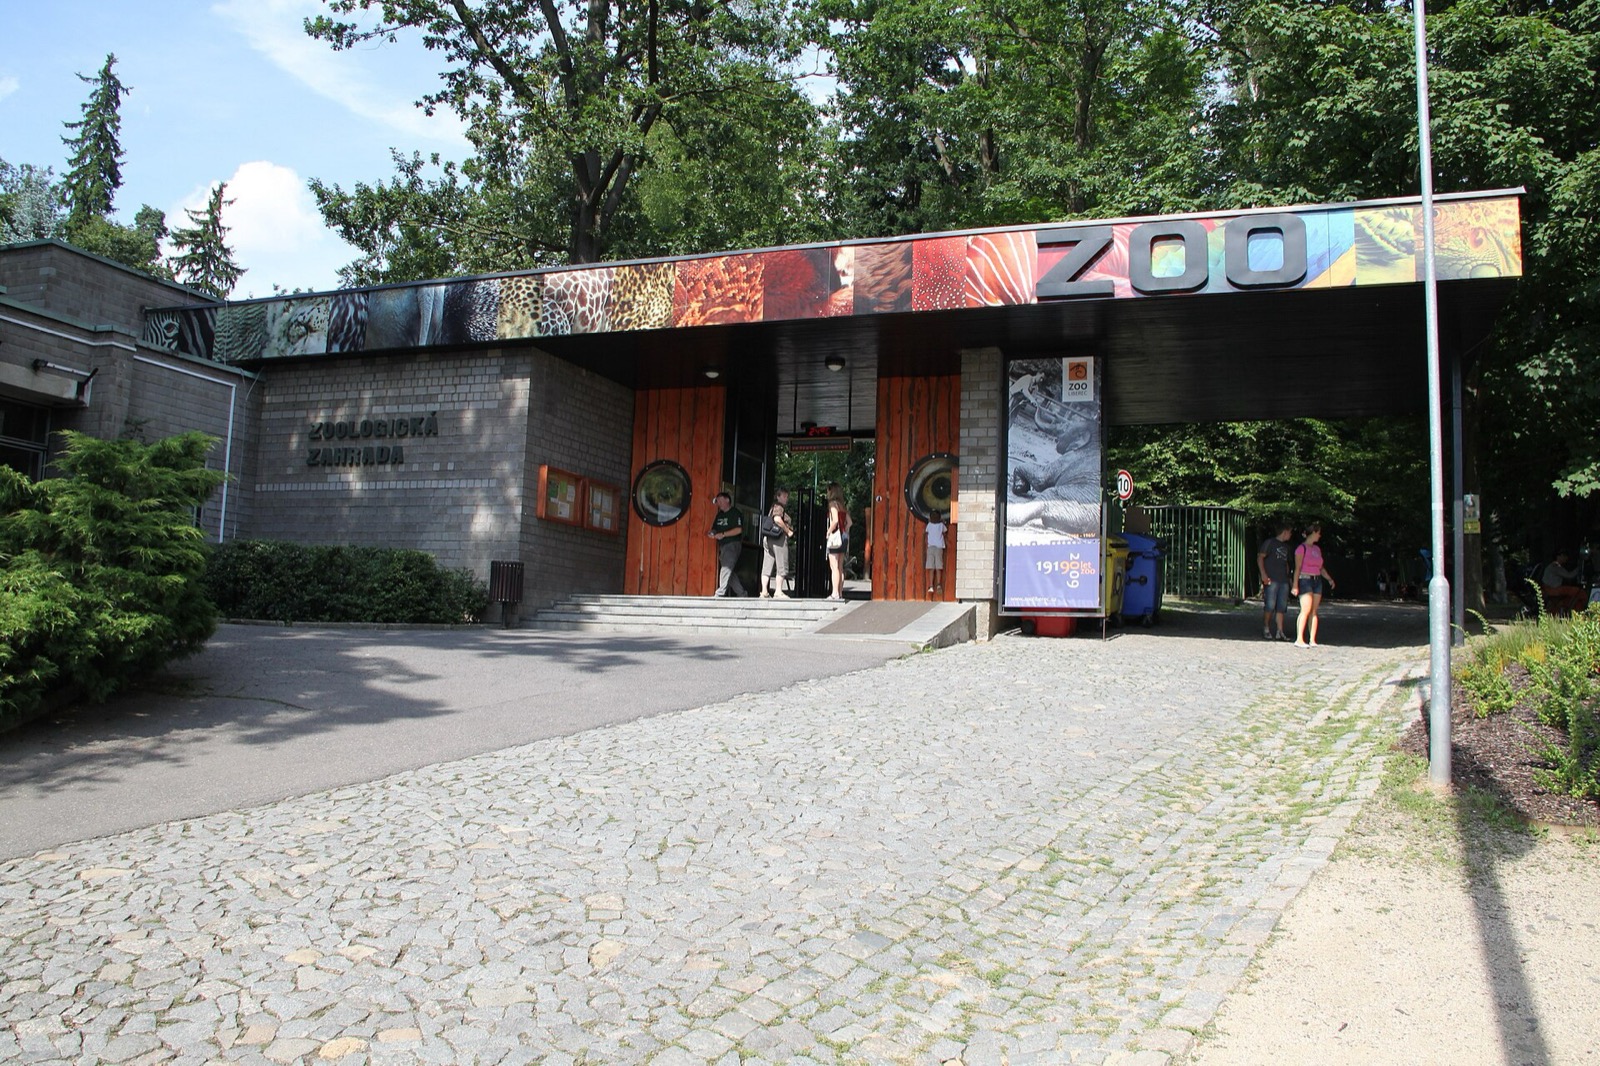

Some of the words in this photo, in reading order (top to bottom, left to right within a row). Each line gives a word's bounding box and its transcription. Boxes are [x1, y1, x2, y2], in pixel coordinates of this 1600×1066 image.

[1036, 213, 1307, 298] ZOO
[1068, 382, 1088, 391] ZOO
[308, 411, 439, 440] ZOOLOGICKÁ
[306, 446, 405, 467] ZAHRADA
[1118, 478, 1129, 492] 10
